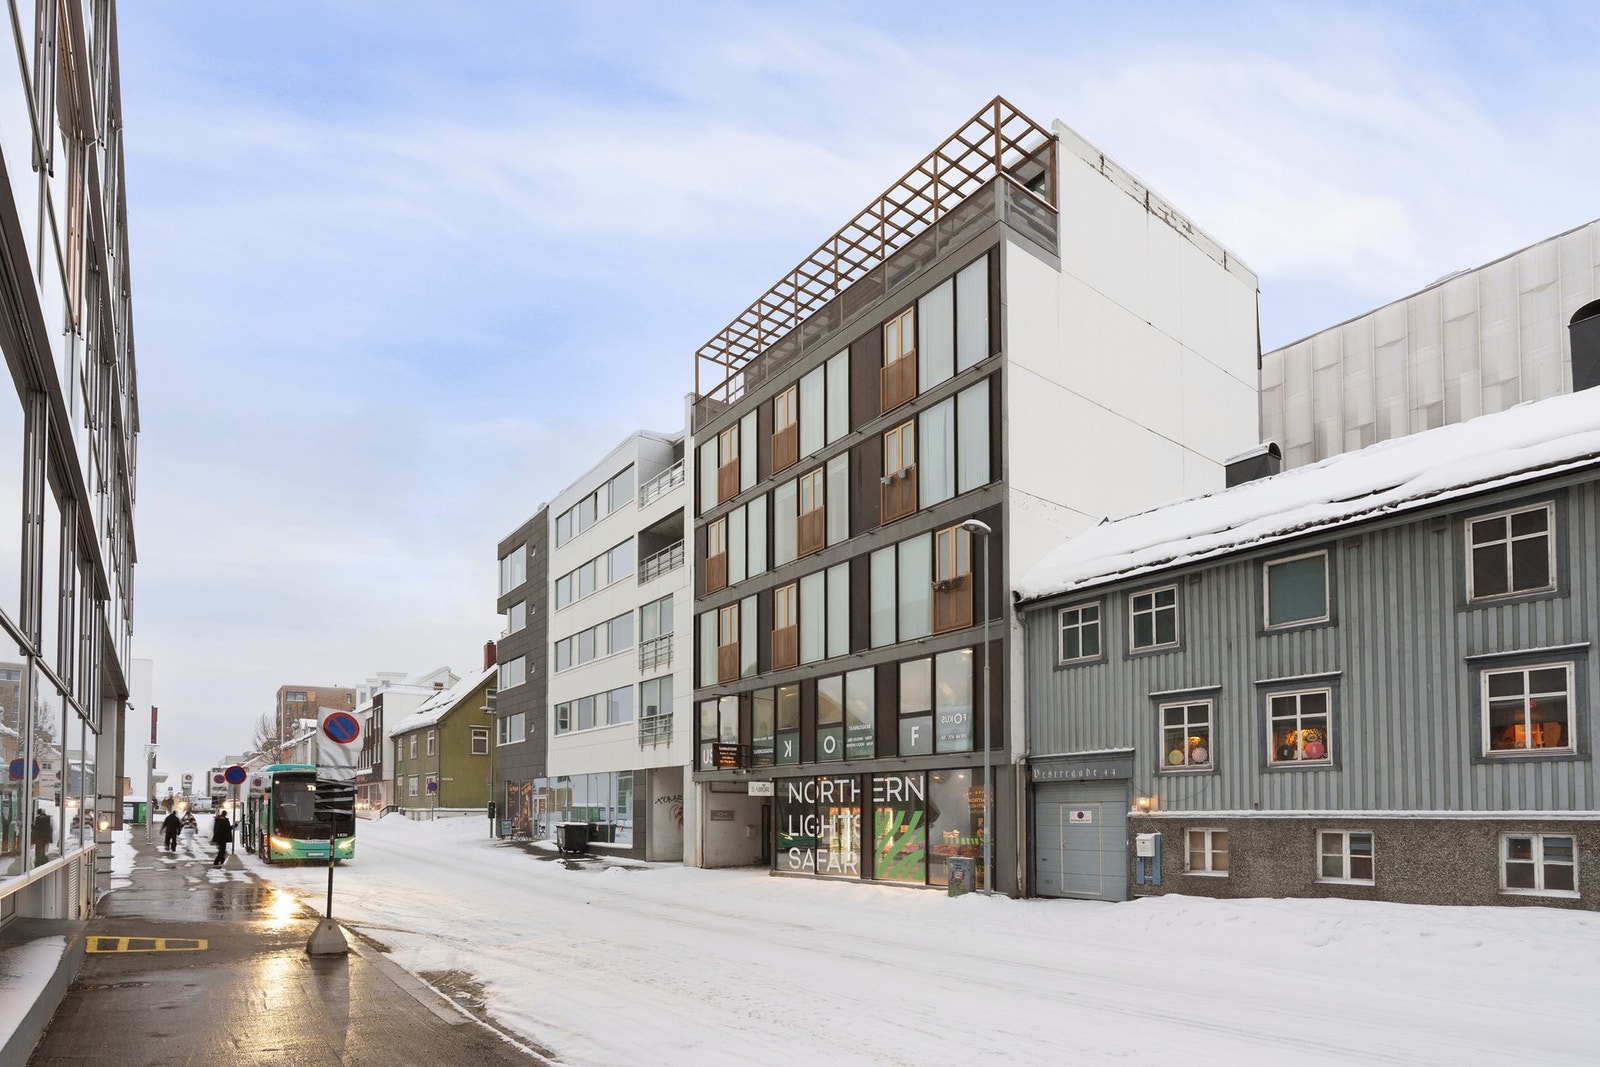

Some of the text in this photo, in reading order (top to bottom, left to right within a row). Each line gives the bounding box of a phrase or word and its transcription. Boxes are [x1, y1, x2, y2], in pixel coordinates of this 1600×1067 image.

[911, 726, 919, 746] F
[788, 775, 924, 804] NORTHERN
[788, 814, 861, 838] LIGHTS
